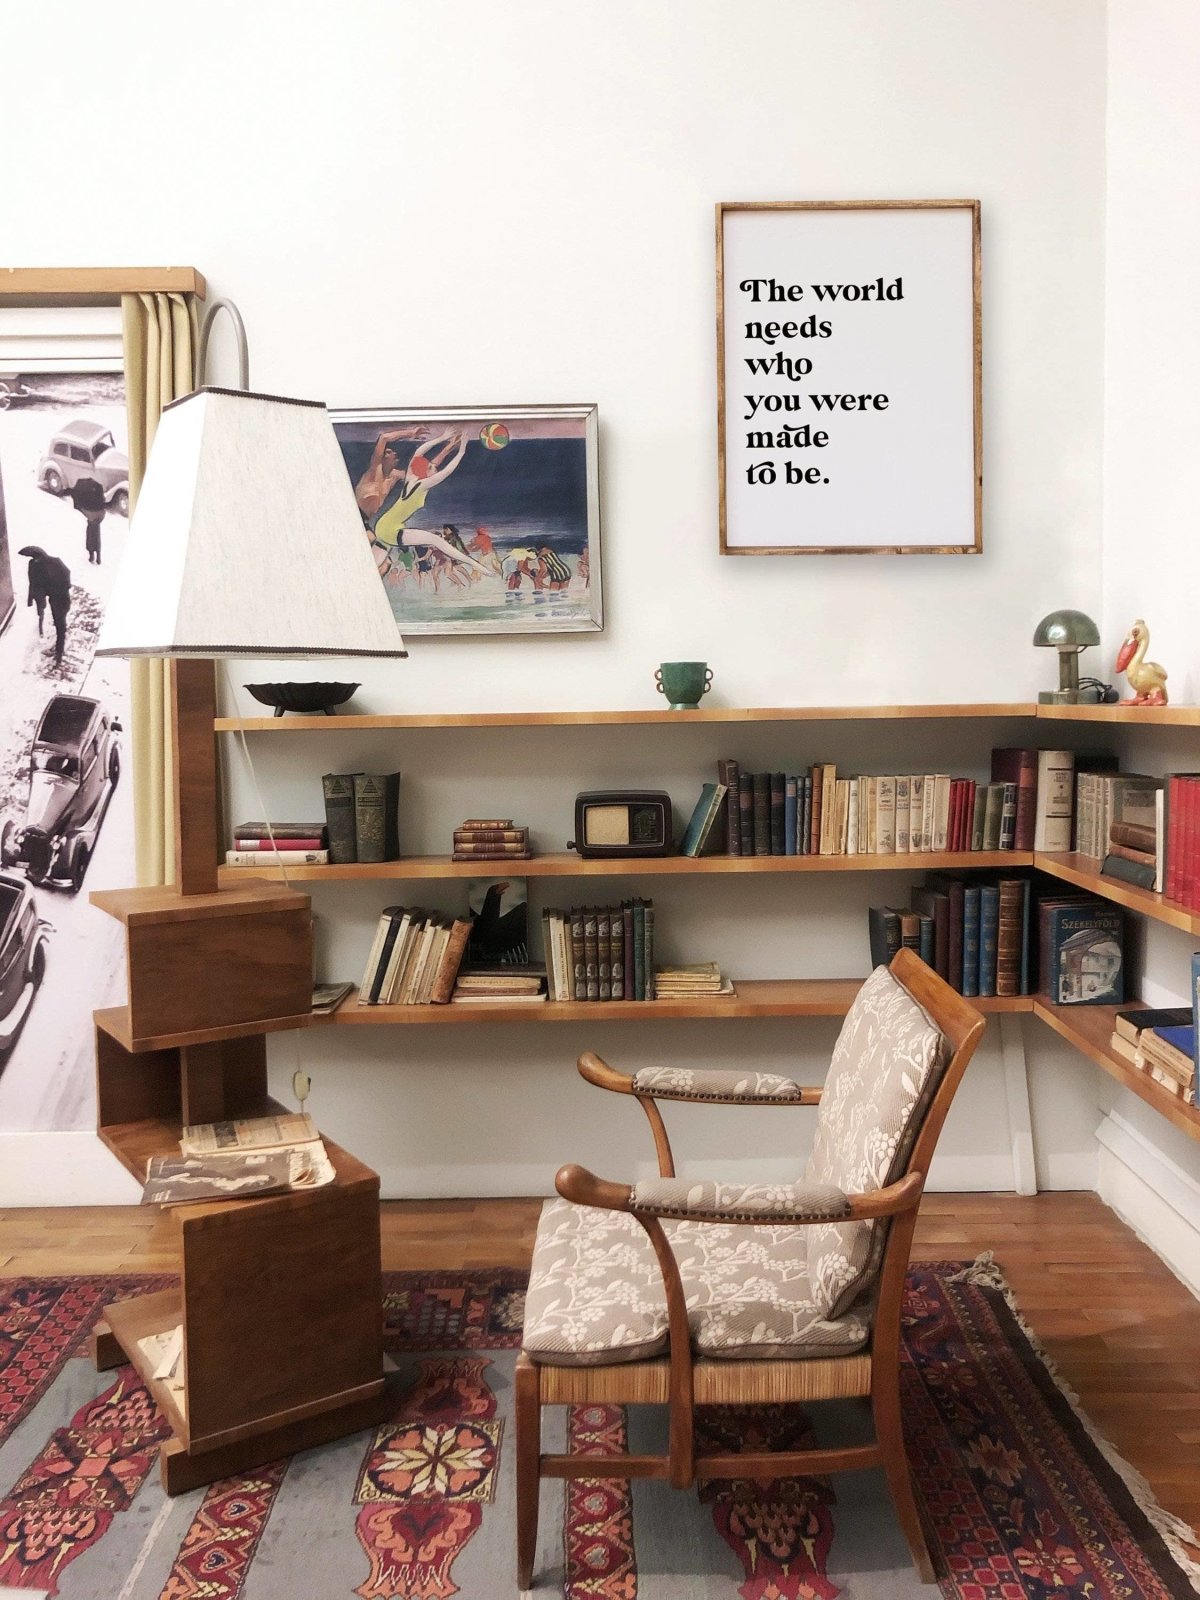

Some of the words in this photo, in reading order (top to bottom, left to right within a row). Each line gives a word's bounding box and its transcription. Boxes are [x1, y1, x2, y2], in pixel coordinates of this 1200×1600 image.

[740, 279, 803, 302] The
[811, 278, 904, 302] world
[745, 315, 833, 345] needs
[744, 352, 812, 381] who
[744, 395, 801, 420] you
[808, 394, 889, 411] were
[746, 424, 829, 448] made
[746, 461, 776, 484] to
[785, 461, 829, 484] be.
